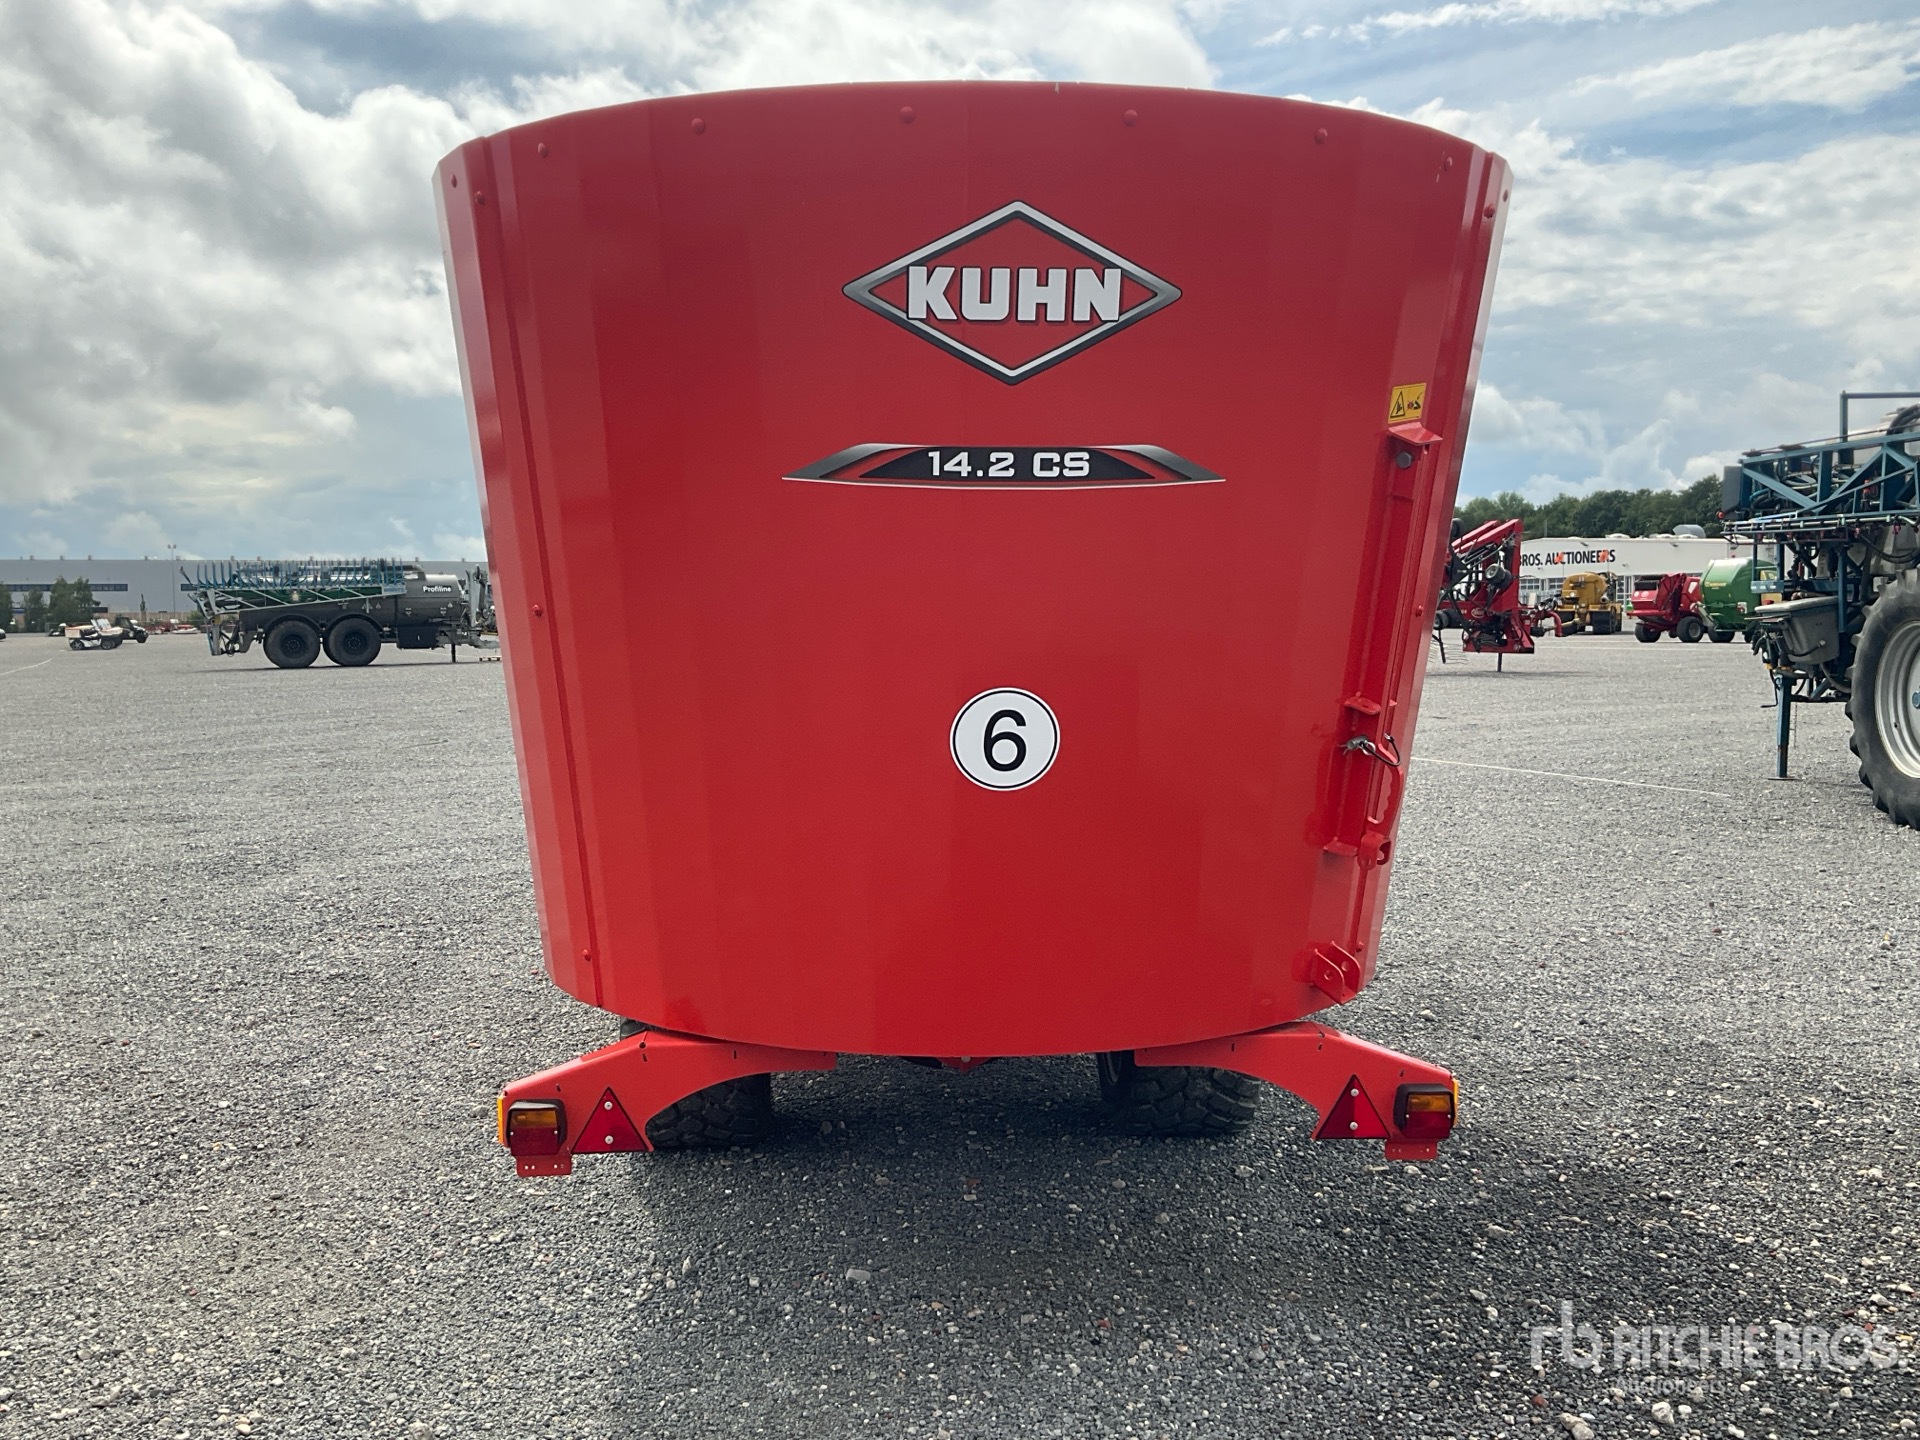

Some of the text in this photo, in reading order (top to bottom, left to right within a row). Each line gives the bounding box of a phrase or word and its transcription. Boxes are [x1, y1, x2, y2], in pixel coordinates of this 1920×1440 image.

[908, 266, 1122, 322] KUHN
[928, 451, 1090, 477] 14.2 CS
[1519, 553, 1543, 567] ROS.
[423, 585, 452, 593] Profiline
[984, 709, 1027, 772] 6
